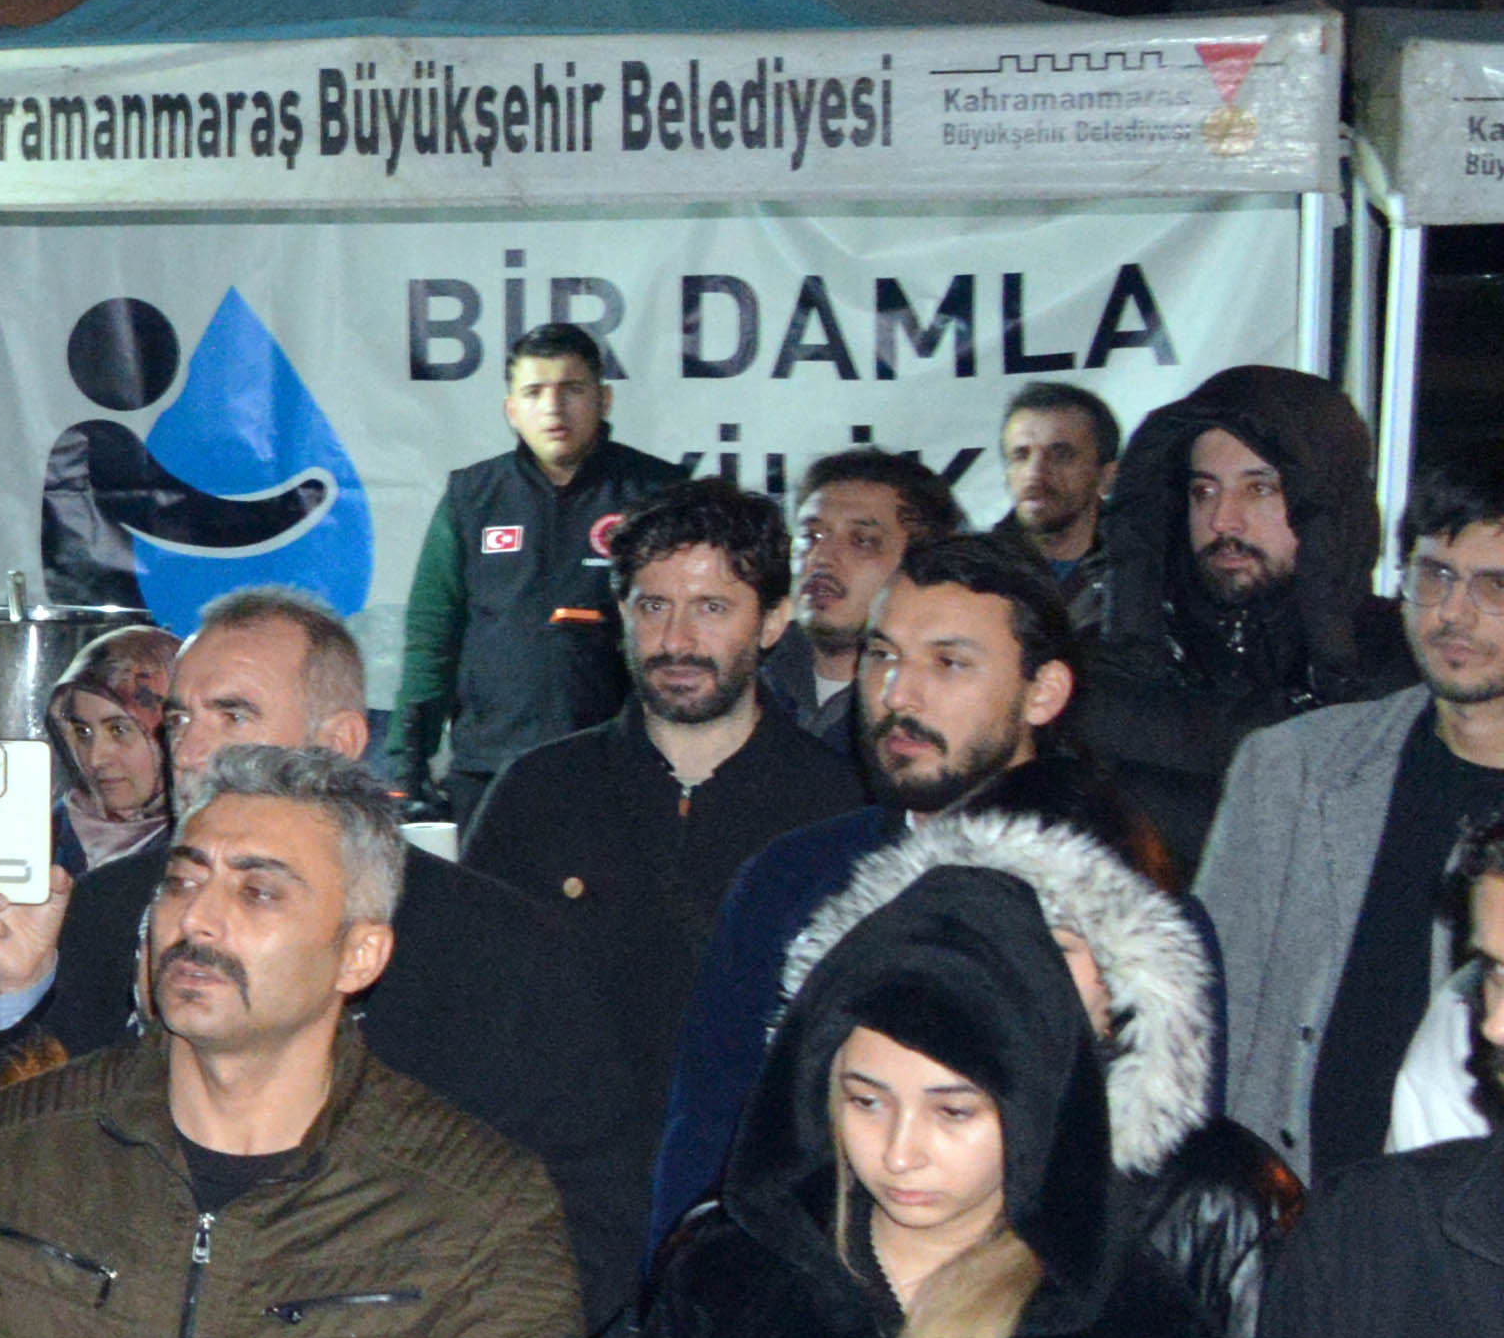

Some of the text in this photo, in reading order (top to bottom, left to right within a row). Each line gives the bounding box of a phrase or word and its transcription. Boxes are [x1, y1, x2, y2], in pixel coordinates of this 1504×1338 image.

[319, 62, 606, 177] Büyükşehir
[622, 53, 893, 171] Belediyesi
[407, 248, 1180, 383] BİR DAMLA
